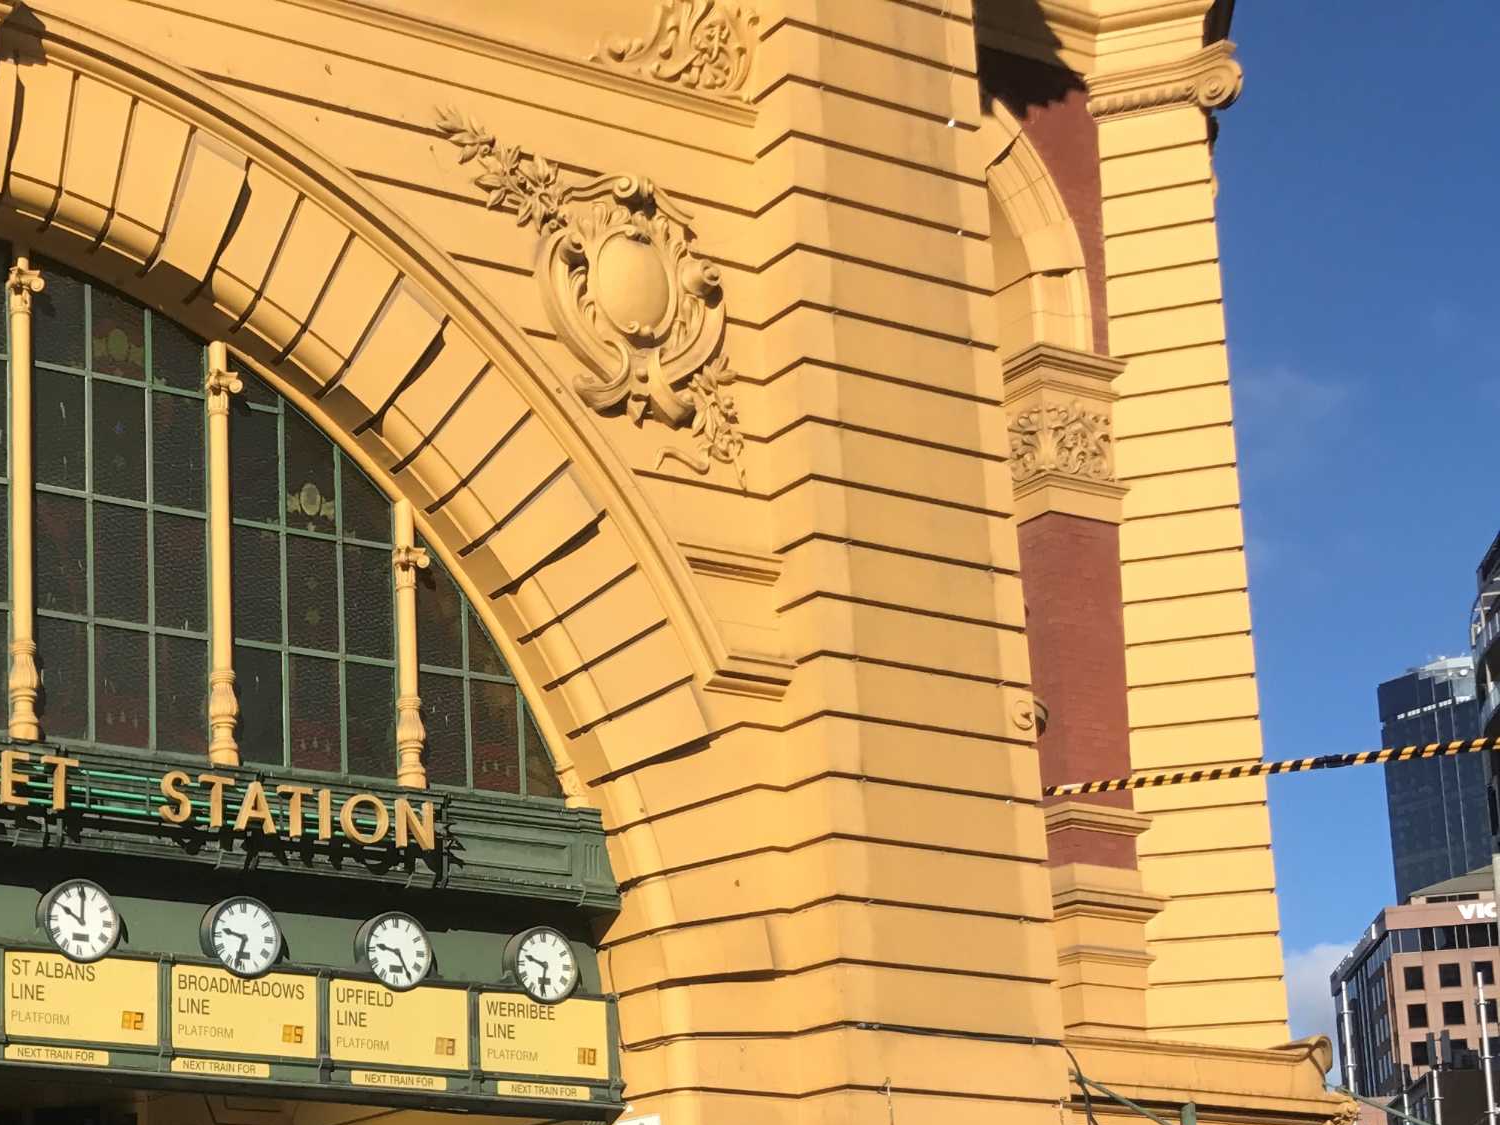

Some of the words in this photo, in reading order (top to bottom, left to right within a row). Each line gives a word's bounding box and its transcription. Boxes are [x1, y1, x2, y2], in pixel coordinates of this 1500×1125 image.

[158, 770, 435, 851] STATION
[11, 959, 31, 976] ST
[34, 961, 96, 982] ALBANS
[11, 983, 45, 1001] LINE
[178, 974, 305, 1000] BROADMEADOWS
[336, 987, 394, 1007] UPFIELD
[178, 998, 210, 1015] LINE
[486, 1000, 555, 1020] WERRIBEE
[11, 1010, 70, 1025] PLATFORM
[336, 1011, 367, 1027] LINE
[178, 1024, 234, 1039] PLATFORM
[486, 1022, 515, 1040] LINE
[336, 1036, 389, 1051] PLATFORM
[17, 1048, 43, 1058] NEXT
[45, 1049, 73, 1060] TRAIN
[75, 1051, 94, 1061] FOR
[487, 1048, 538, 1062] PLATFORM
[182, 1060, 206, 1070] NEXT
[208, 1062, 235, 1073] TRAIN
[237, 1064, 256, 1074] FOR
[364, 1074, 388, 1083] NEXT
[389, 1075, 415, 1085] TRAIN
[416, 1077, 434, 1086] FOR
[511, 1084, 533, 1093] NEXT
[534, 1085, 558, 1096] TRAIN
[560, 1087, 577, 1097] FOR
